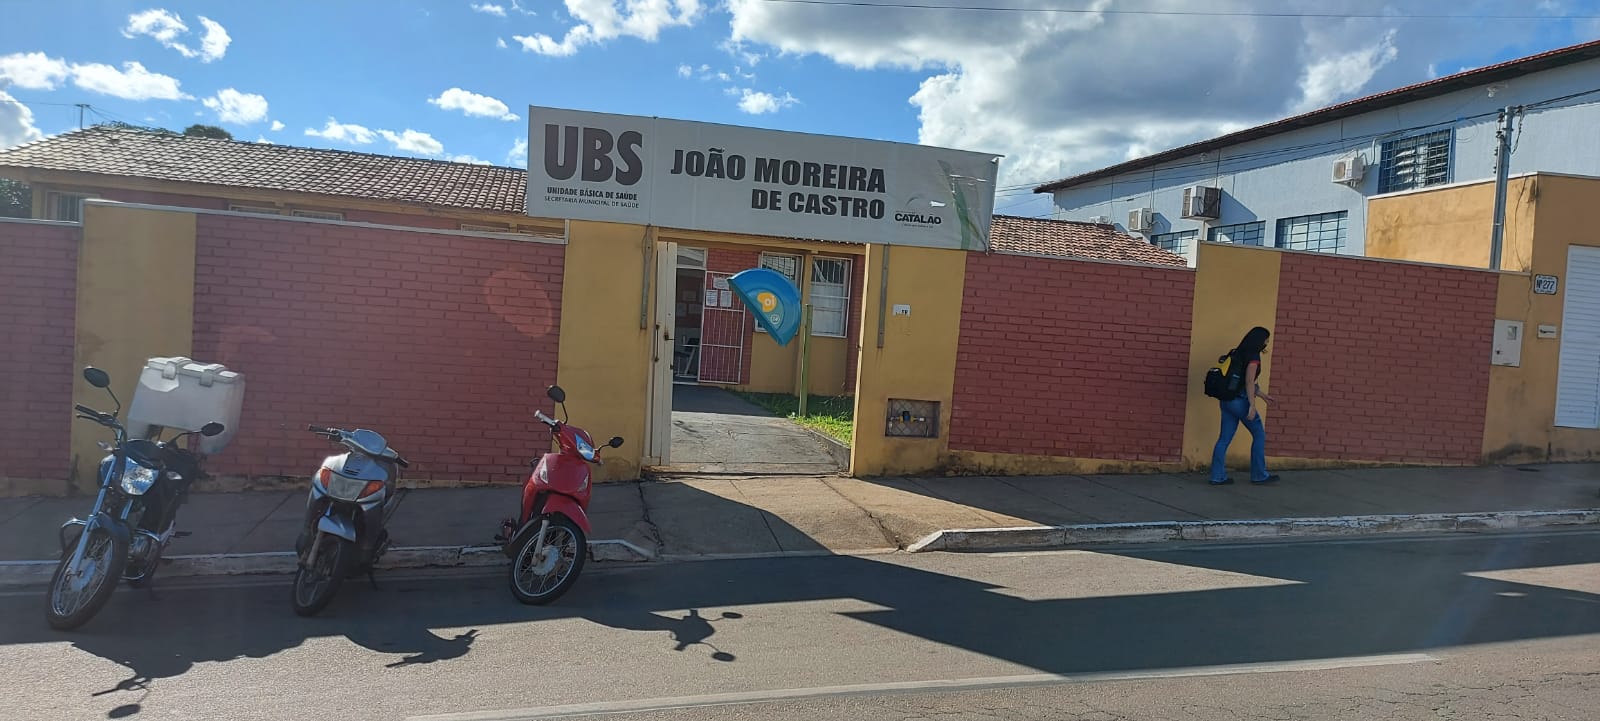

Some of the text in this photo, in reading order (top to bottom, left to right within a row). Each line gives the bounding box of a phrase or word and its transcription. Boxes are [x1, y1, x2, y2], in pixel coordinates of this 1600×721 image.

[545, 124, 643, 186] UBS
[671, 147, 886, 193] JOÃO MOREIRA
[545, 196, 578, 204] SECRETARIA
[547, 187, 578, 196] UNIDADE
[580, 188, 604, 198] BÁSICA
[616, 192, 638, 200] SAÚDE
[752, 188, 886, 220] DE CASTRO
[894, 213, 942, 224] CATALÃO
